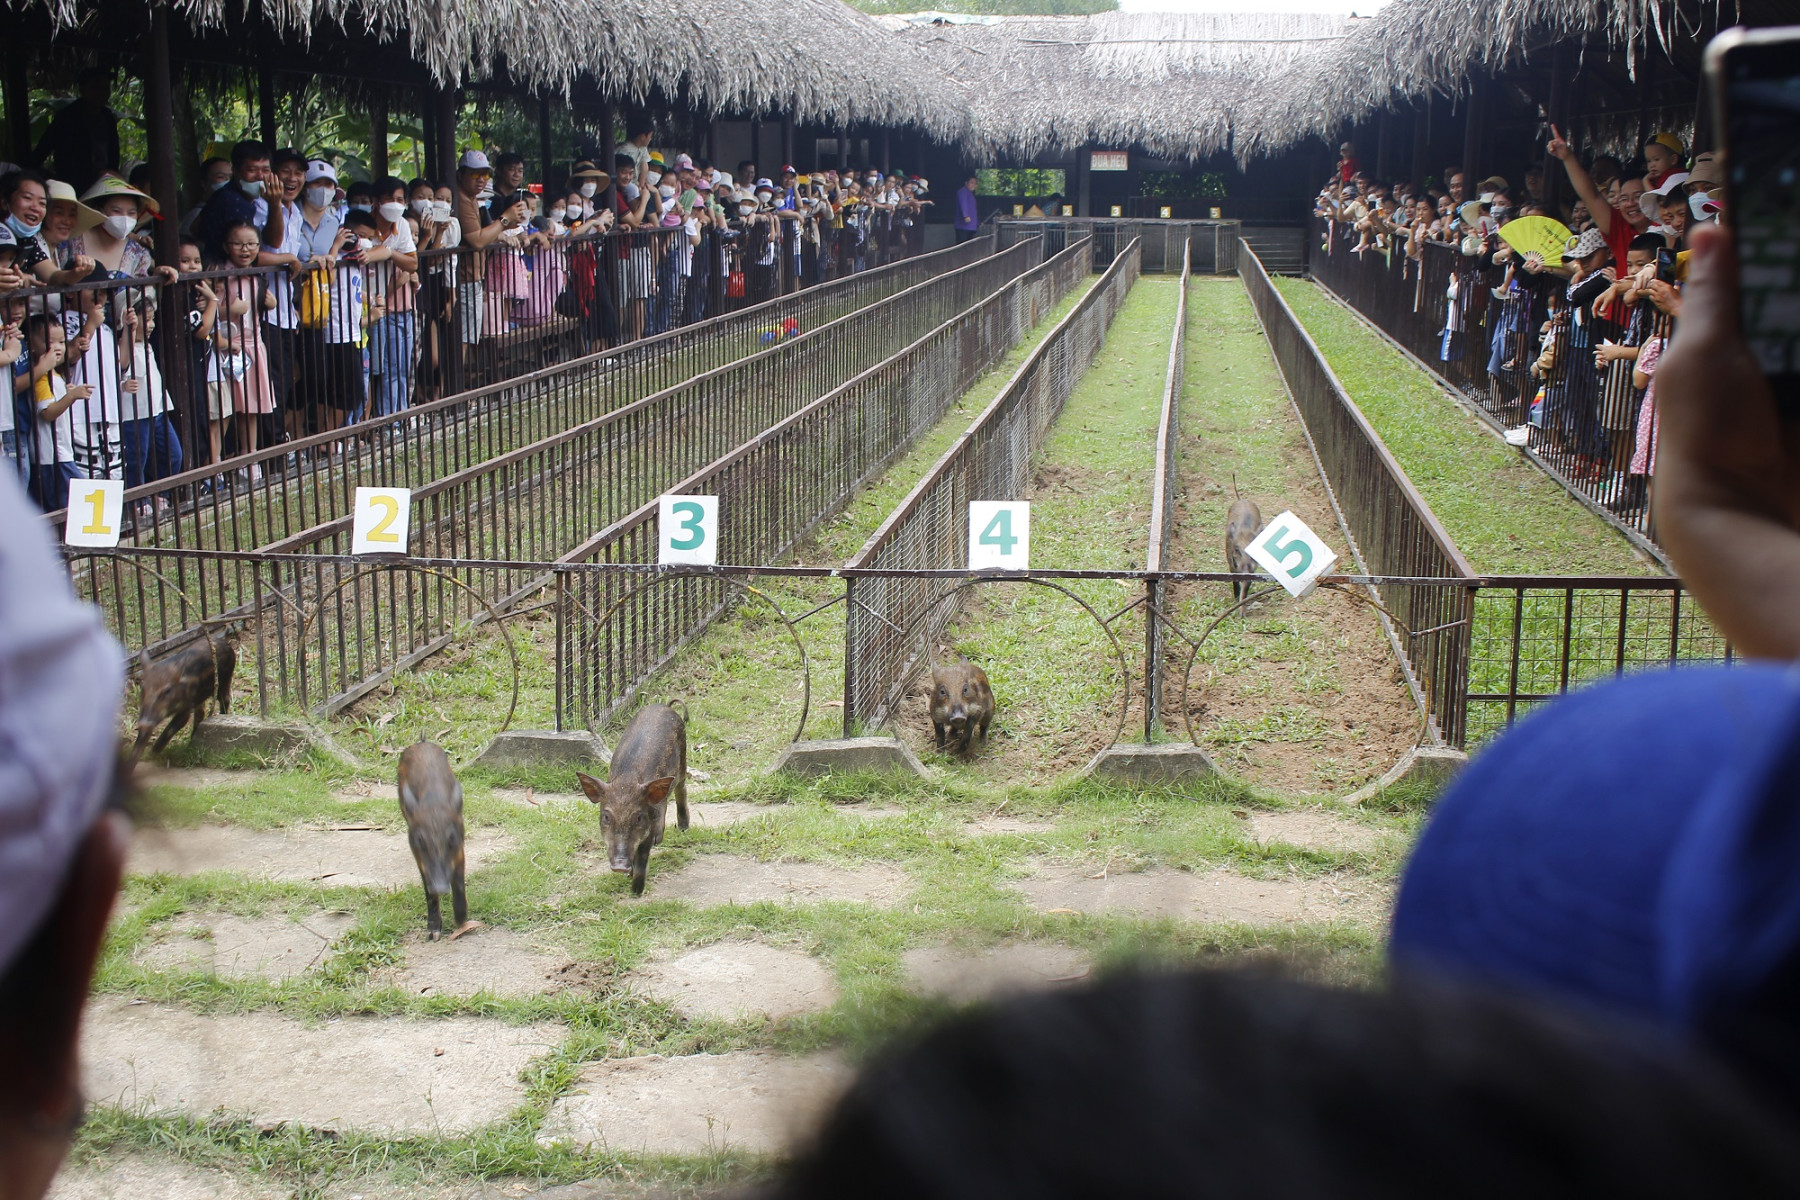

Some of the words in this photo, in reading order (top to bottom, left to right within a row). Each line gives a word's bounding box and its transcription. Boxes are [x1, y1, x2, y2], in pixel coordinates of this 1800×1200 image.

[1110, 154, 1127, 168] HEO
[1160, 207, 1169, 217] 4
[82, 489, 112, 535] 1
[366, 495, 399, 543] 2
[670, 501, 706, 550] 3
[979, 509, 1018, 556] 4
[1262, 525, 1313, 579] 5
